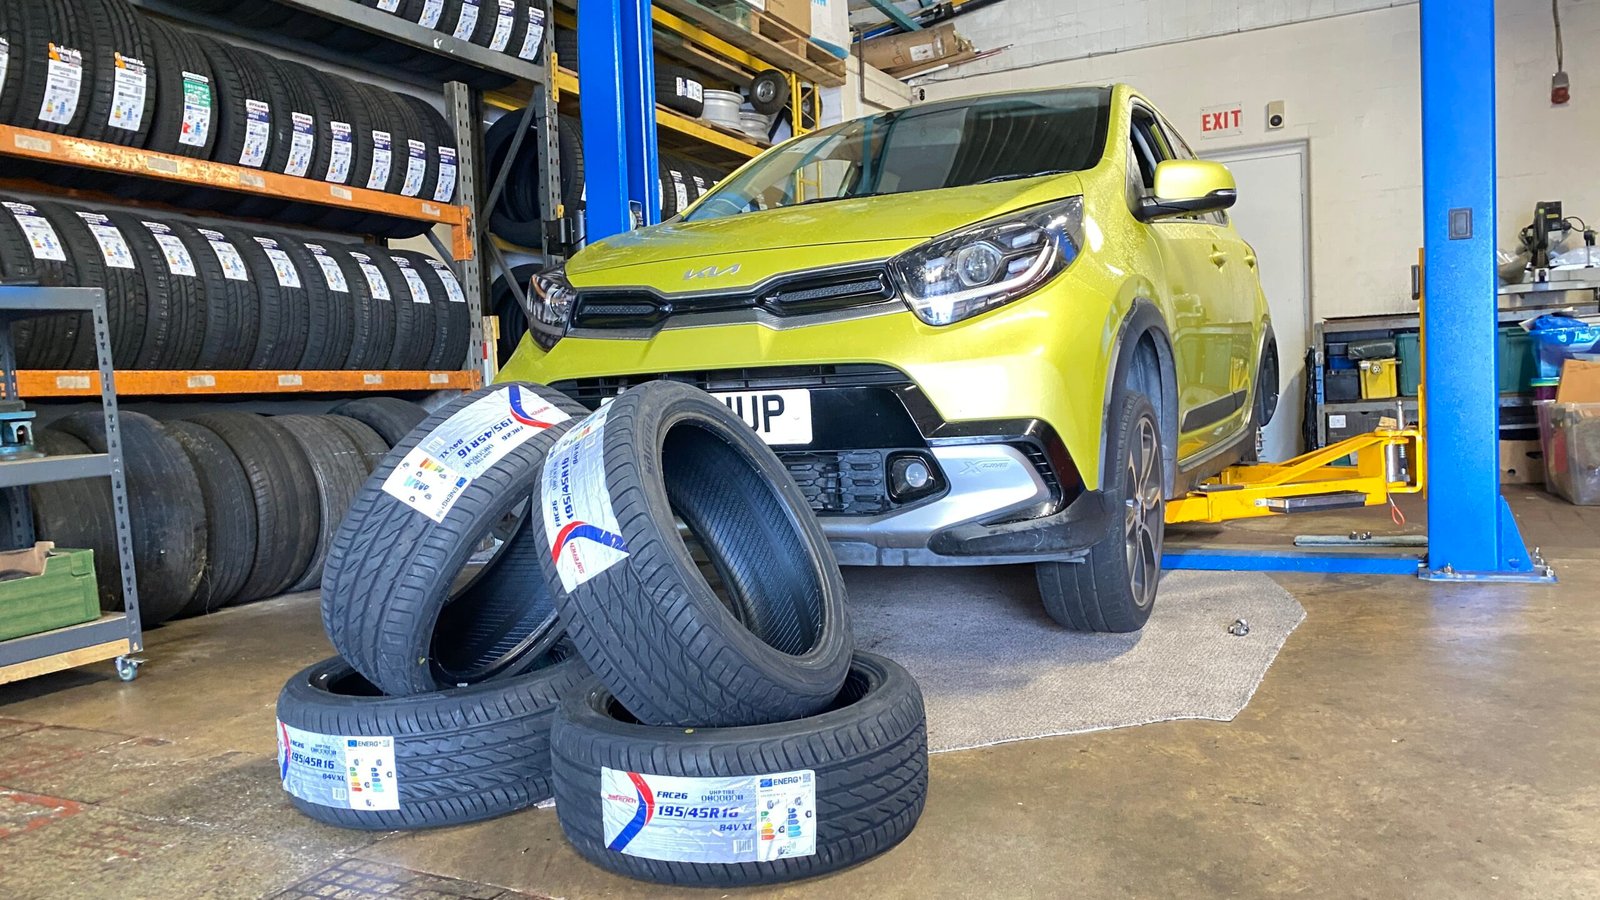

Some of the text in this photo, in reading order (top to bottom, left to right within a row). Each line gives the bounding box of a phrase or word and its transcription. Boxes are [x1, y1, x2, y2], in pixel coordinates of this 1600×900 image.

[1202, 109, 1242, 132] EXIT
[683, 263, 742, 280] KIA
[457, 418, 514, 459] 195/45R16
[501, 425, 524, 441] FRC26
[561, 457, 574, 520] 195/45R16
[552, 499, 562, 528] FRC26
[291, 751, 335, 769] 195/45R16
[656, 790, 689, 800] FRC26
[658, 804, 740, 819] 195/45R16
[719, 823, 753, 832] 84V XL
